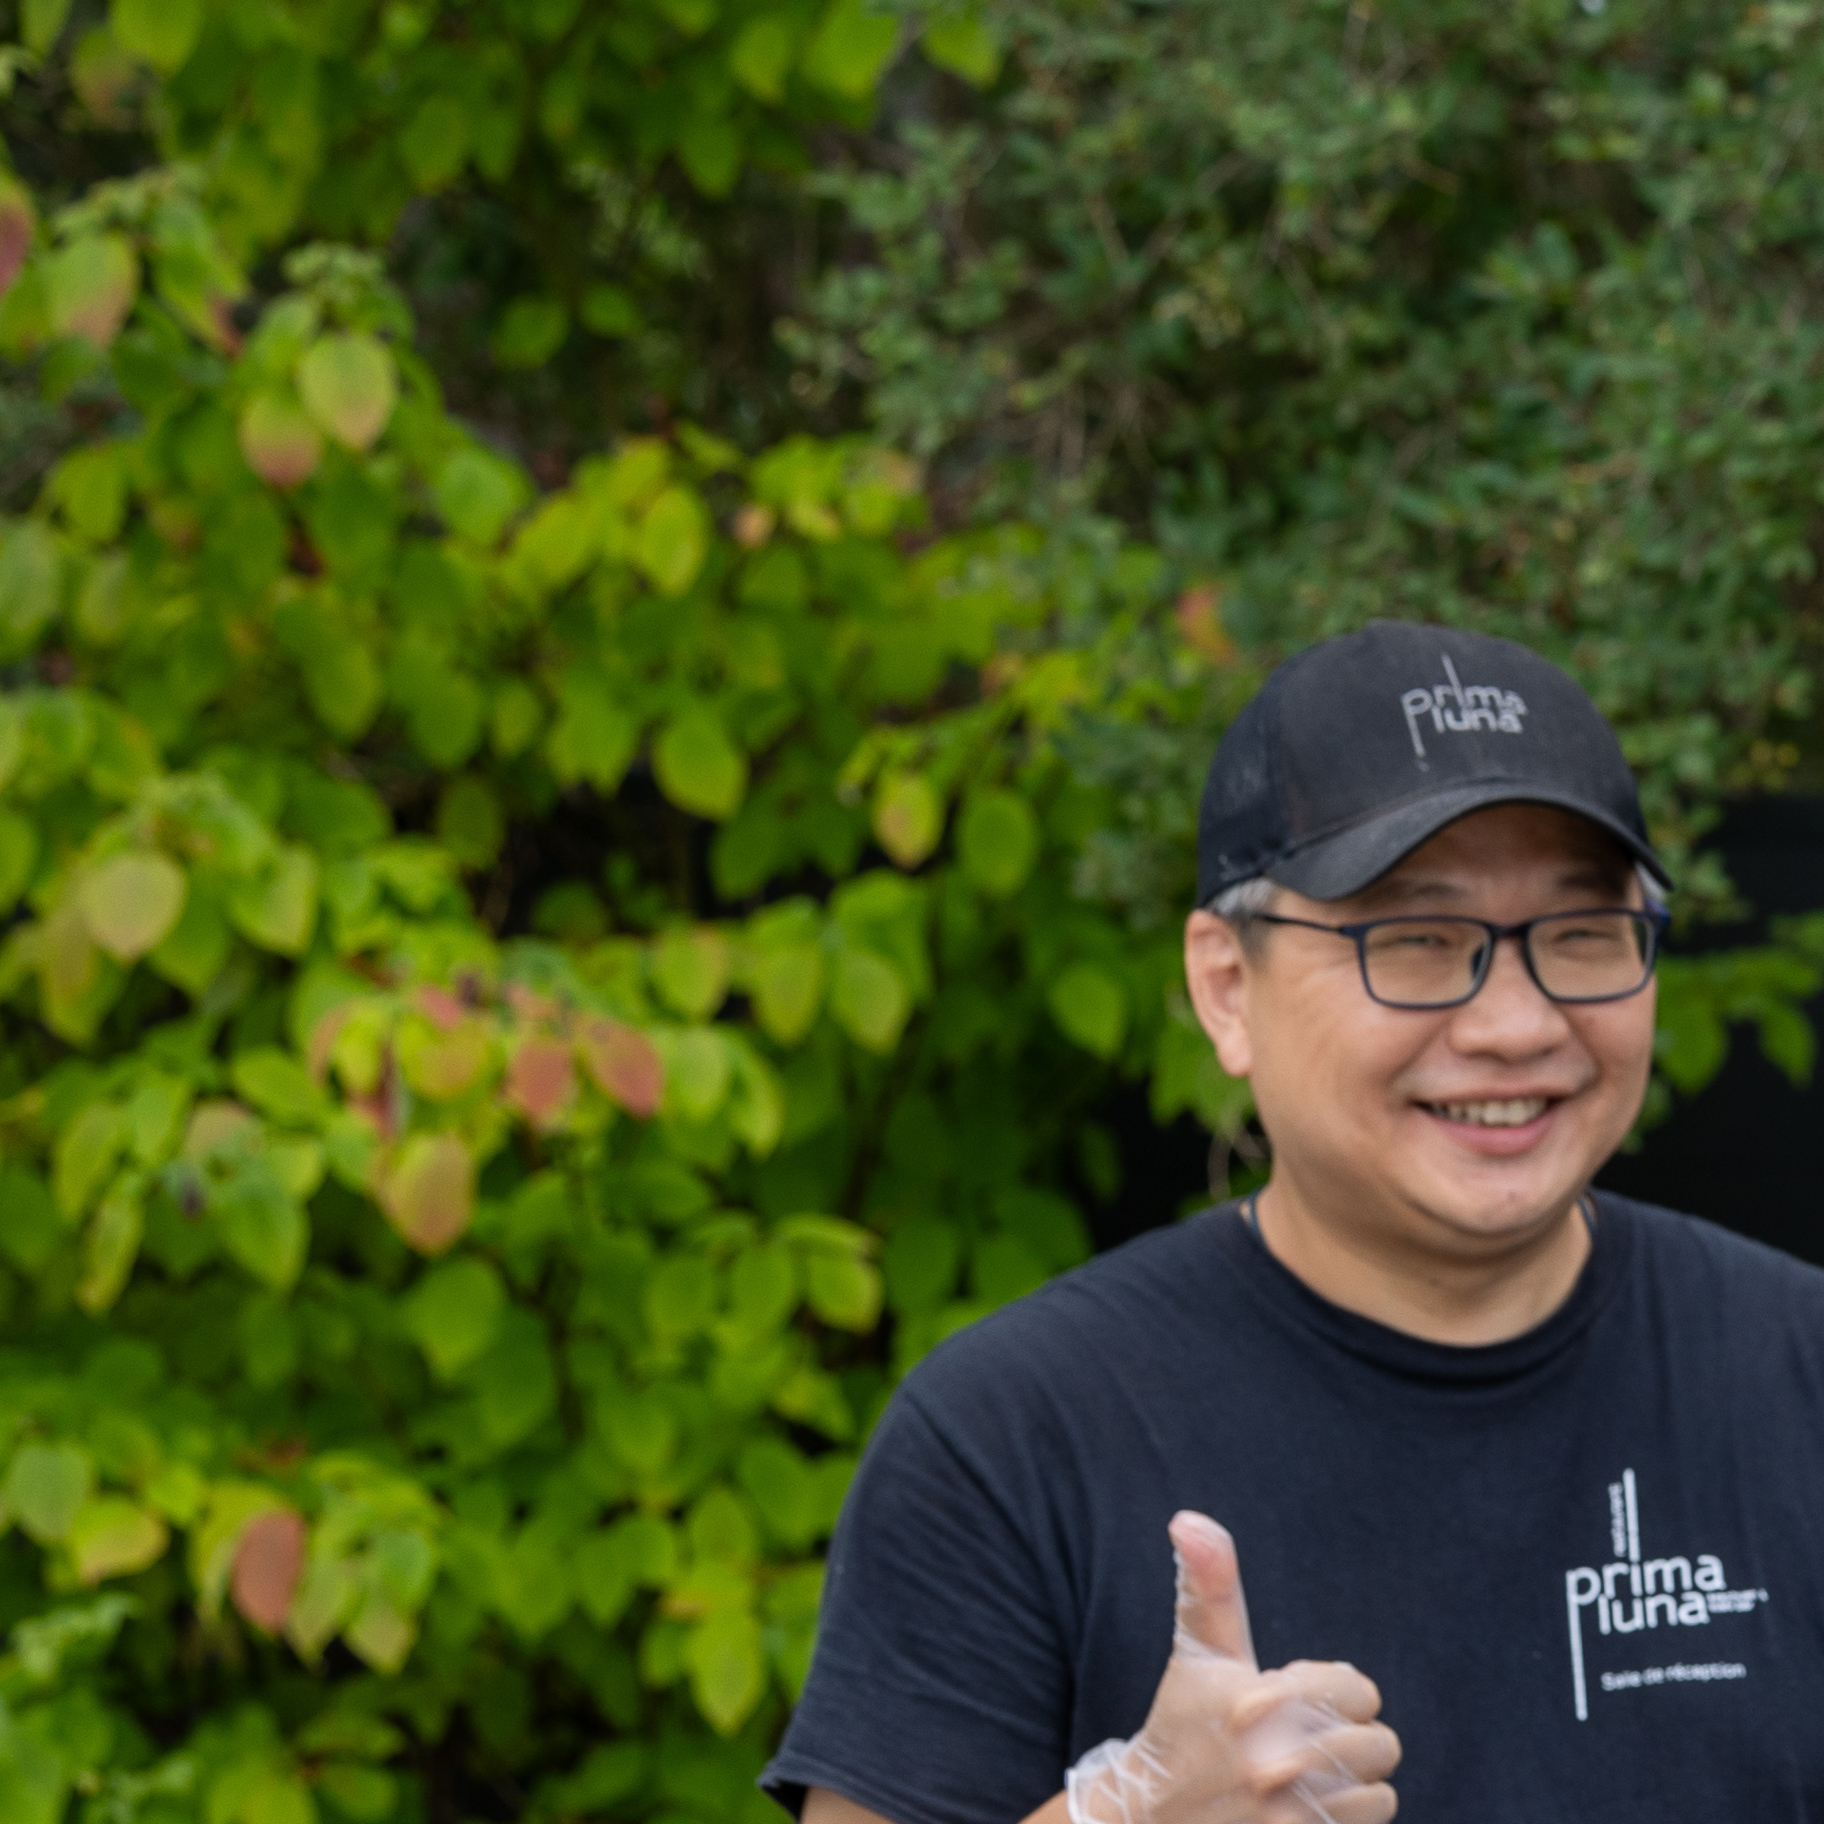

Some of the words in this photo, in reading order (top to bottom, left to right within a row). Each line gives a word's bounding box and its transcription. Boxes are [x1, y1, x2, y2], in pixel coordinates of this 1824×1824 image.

[1401, 653, 1528, 757] prima
[1430, 704, 1524, 734] luna
[1565, 1467, 1727, 1722] prima
[1597, 1590, 1711, 1635] luna
